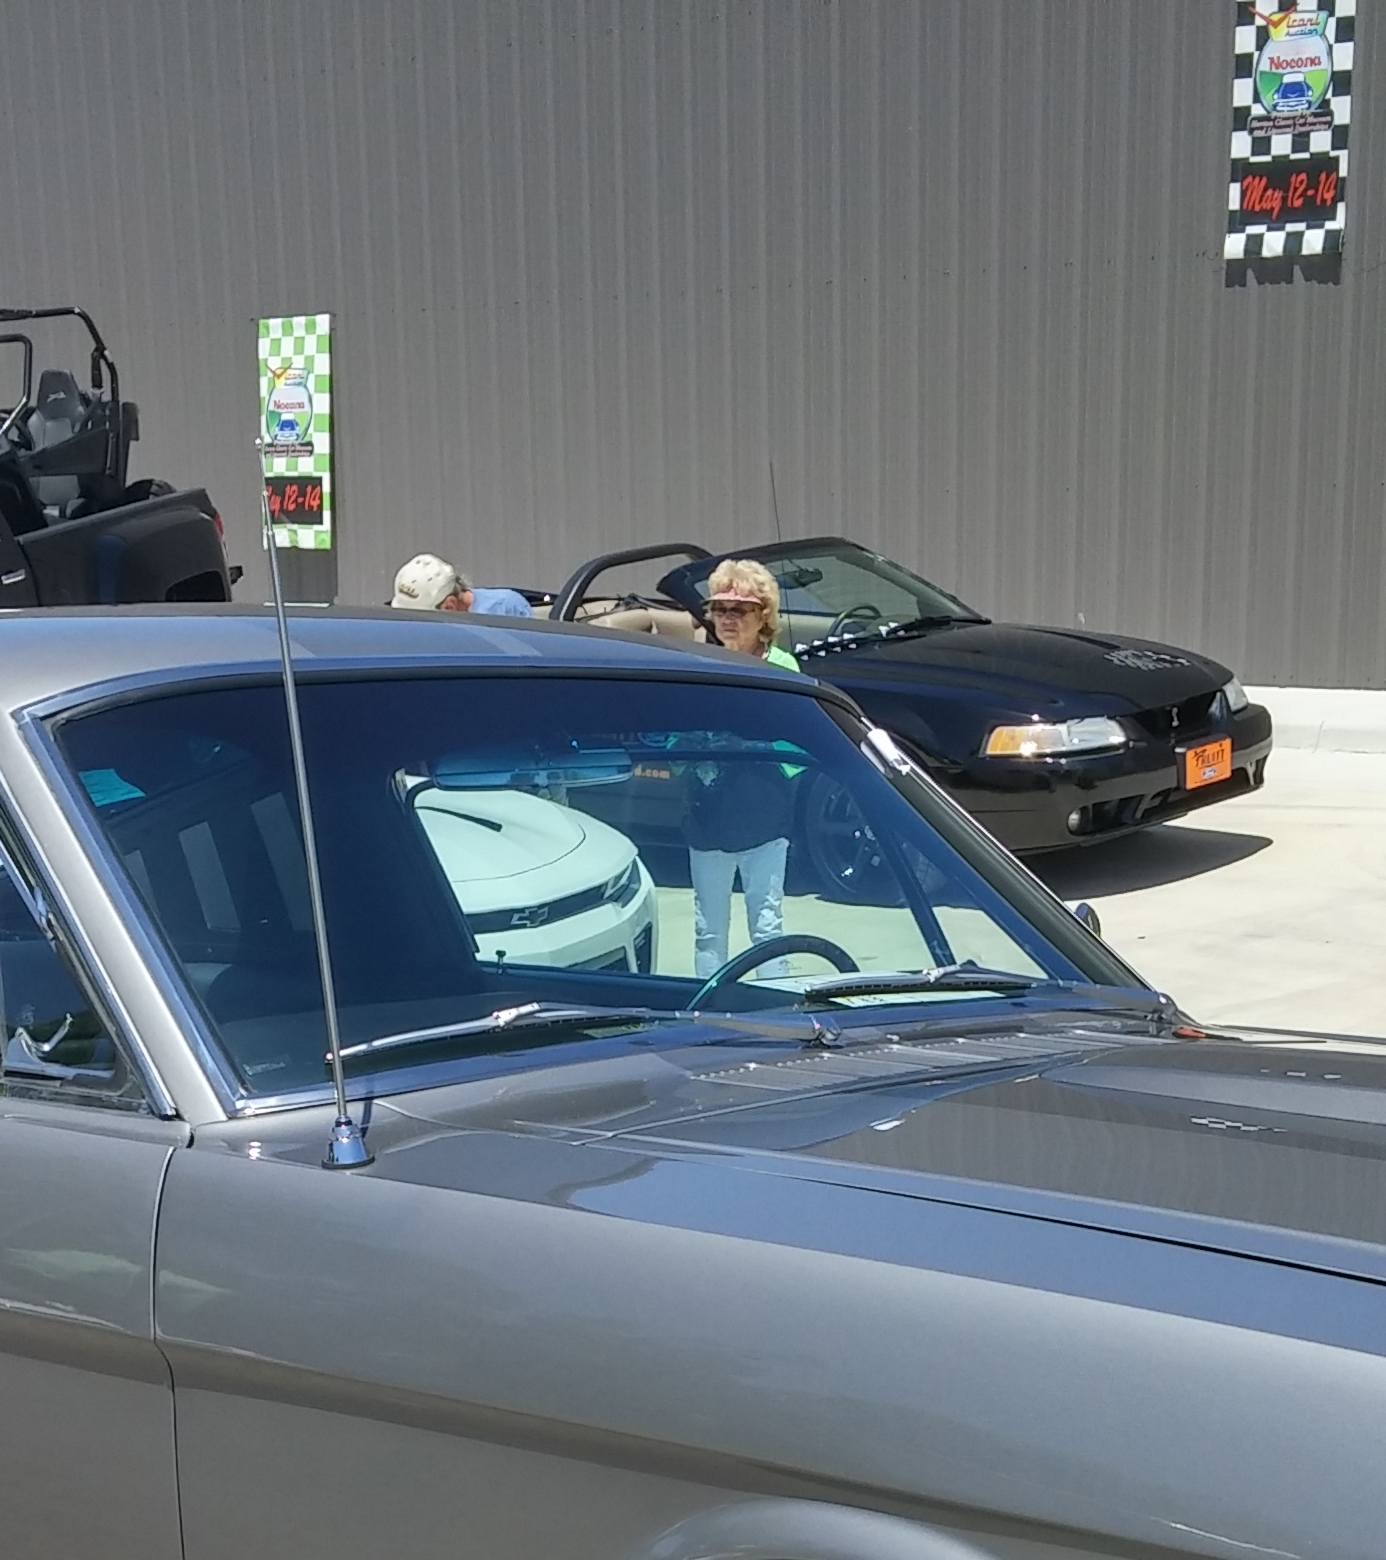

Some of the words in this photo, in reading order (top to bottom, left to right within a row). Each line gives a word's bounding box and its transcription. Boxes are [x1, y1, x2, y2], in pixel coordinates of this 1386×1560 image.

[1268, 55, 1322, 71] Nocona
[1242, 174, 1283, 220] May
[1287, 171, 1338, 208] 12-14
[273, 399, 305, 410] Nocona
[283, 483, 321, 512] 12-14
